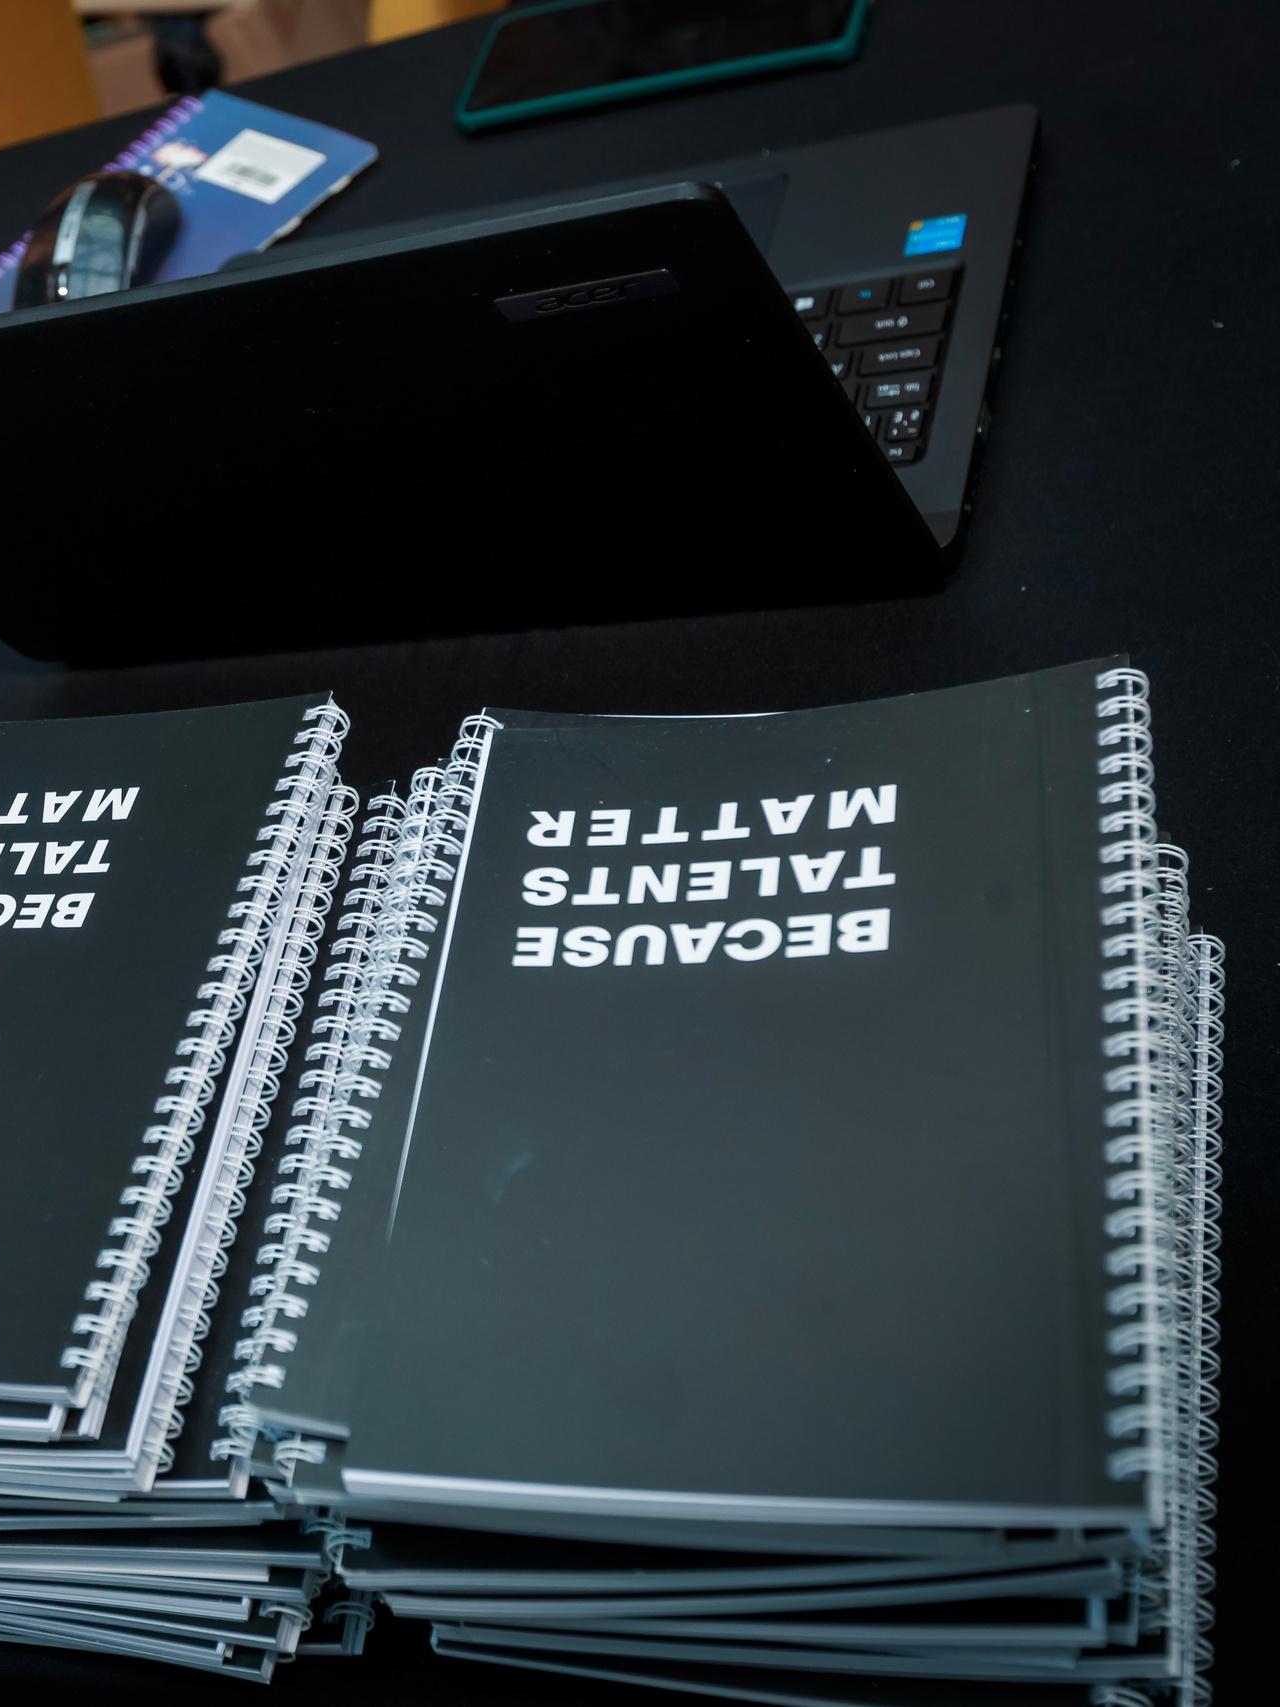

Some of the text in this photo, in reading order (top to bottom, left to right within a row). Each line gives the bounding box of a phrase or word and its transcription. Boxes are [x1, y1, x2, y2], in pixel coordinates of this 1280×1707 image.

[535, 281, 640, 314] acer
[526, 783, 898, 847] MATTER
[521, 846, 897, 907] TALENTS
[512, 907, 891, 968] BECAUSE
